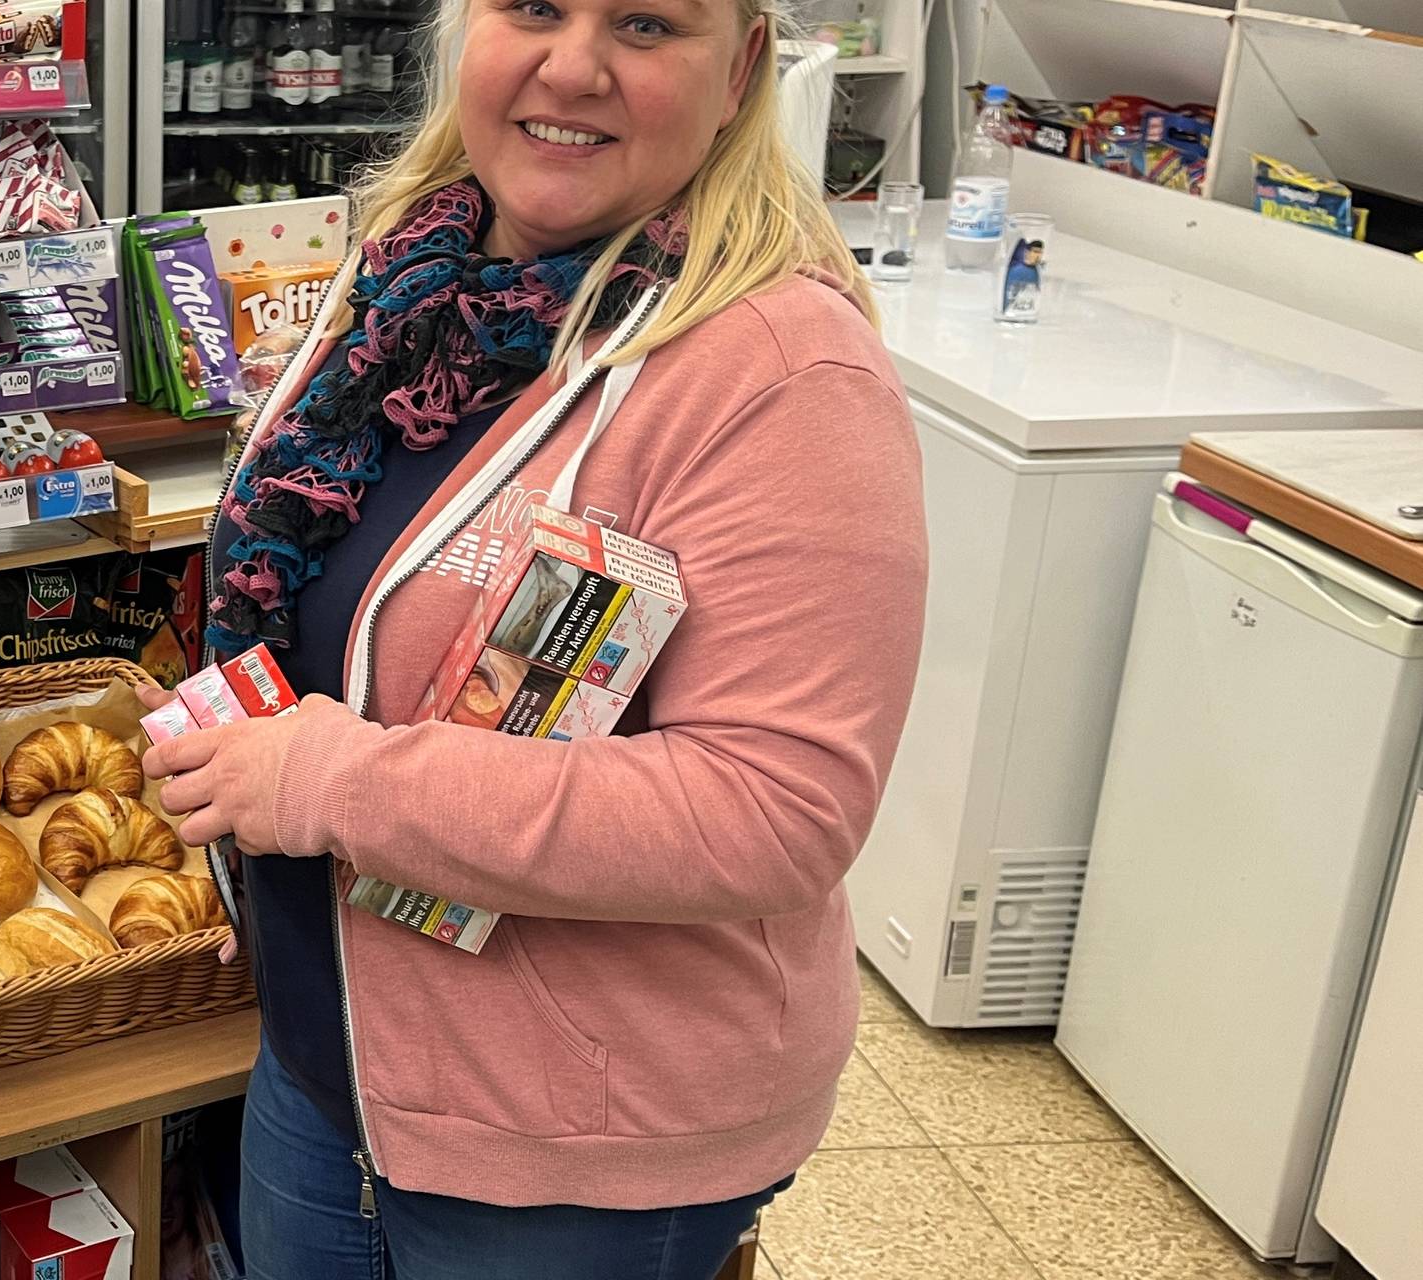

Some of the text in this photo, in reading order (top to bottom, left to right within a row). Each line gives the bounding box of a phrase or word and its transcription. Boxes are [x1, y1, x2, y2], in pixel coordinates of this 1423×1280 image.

[28, 243, 78, 262] Airwaves
[165, 260, 227, 367] Milka
[38, 367, 86, 385] Airwaves
[46, 480, 75, 492] Extra
[605, 539, 675, 572] ist tödlich
[607, 532, 672, 562] Rauchen
[33, 572, 67, 586] funny-
[608, 565, 680, 598] ist tödlich
[611, 557, 675, 587] Rauchen
[39, 584, 70, 599] frisch
[542, 576, 601, 664] Rauchen verstopft
[556, 609, 601, 669] Ihre Arterien
[529, 691, 541, 707] und
[395, 890, 420, 922] Rauche
[408, 909, 426, 927] Ihre
